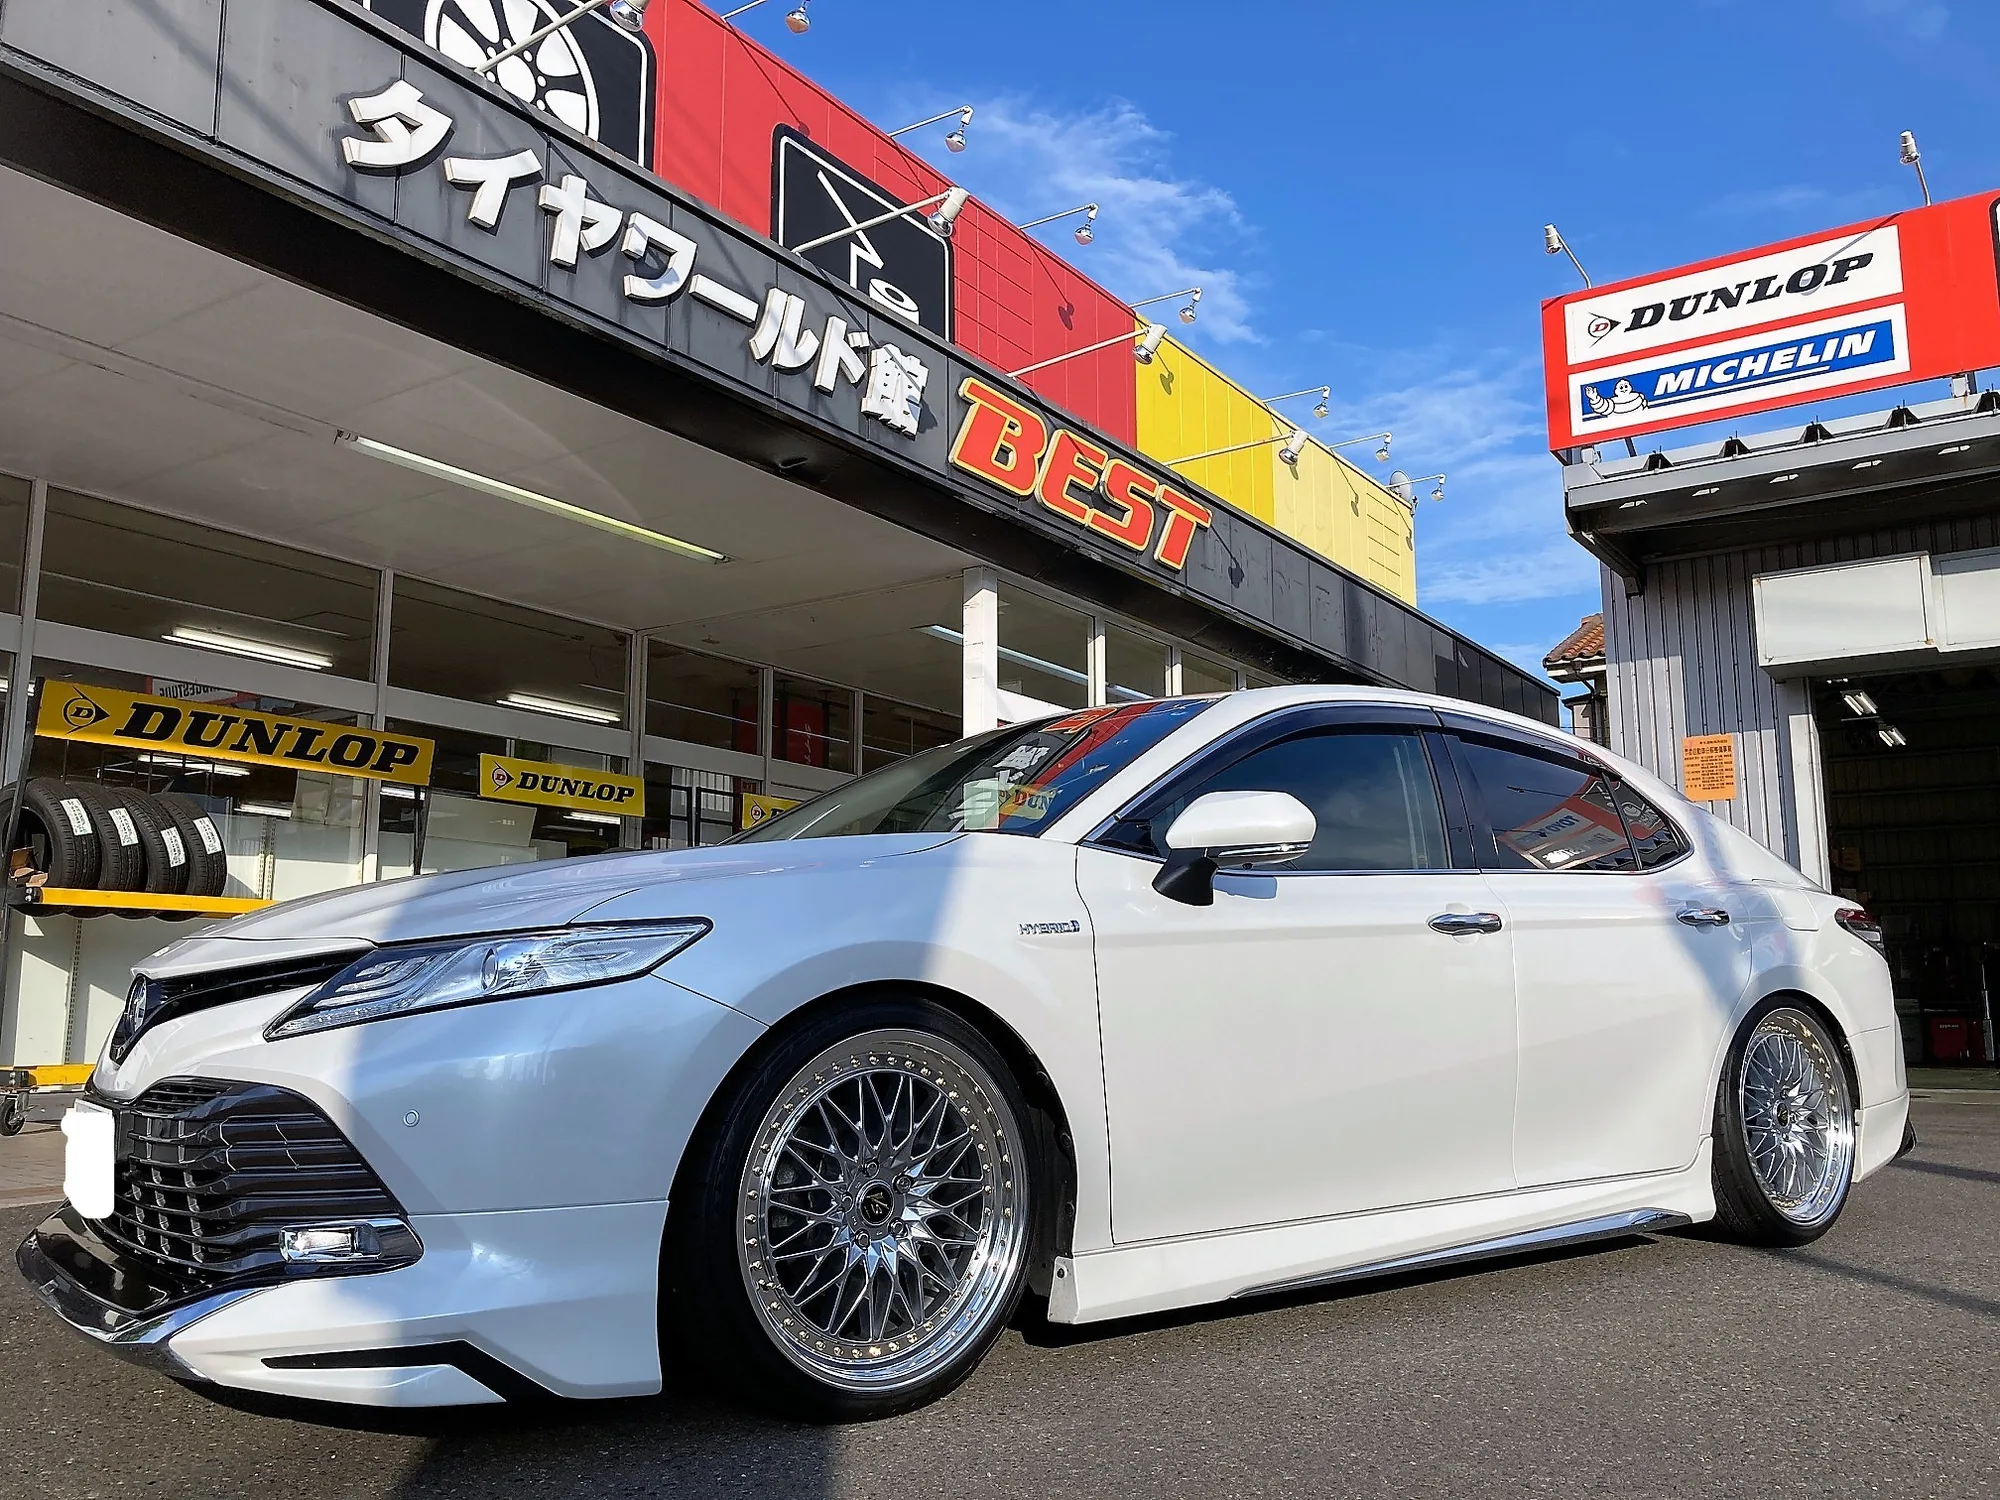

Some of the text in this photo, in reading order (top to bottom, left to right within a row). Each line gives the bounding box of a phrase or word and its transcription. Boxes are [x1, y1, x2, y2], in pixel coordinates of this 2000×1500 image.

[341, 79, 930, 439] タイヤワールド館
[1624, 252, 1874, 333] DUNLOP
[1652, 329, 1877, 396] MICHELIN
[948, 375, 1213, 572] BEST
[114, 702, 420, 774] DUNLOP
[516, 771, 636, 803] DUNLOP
